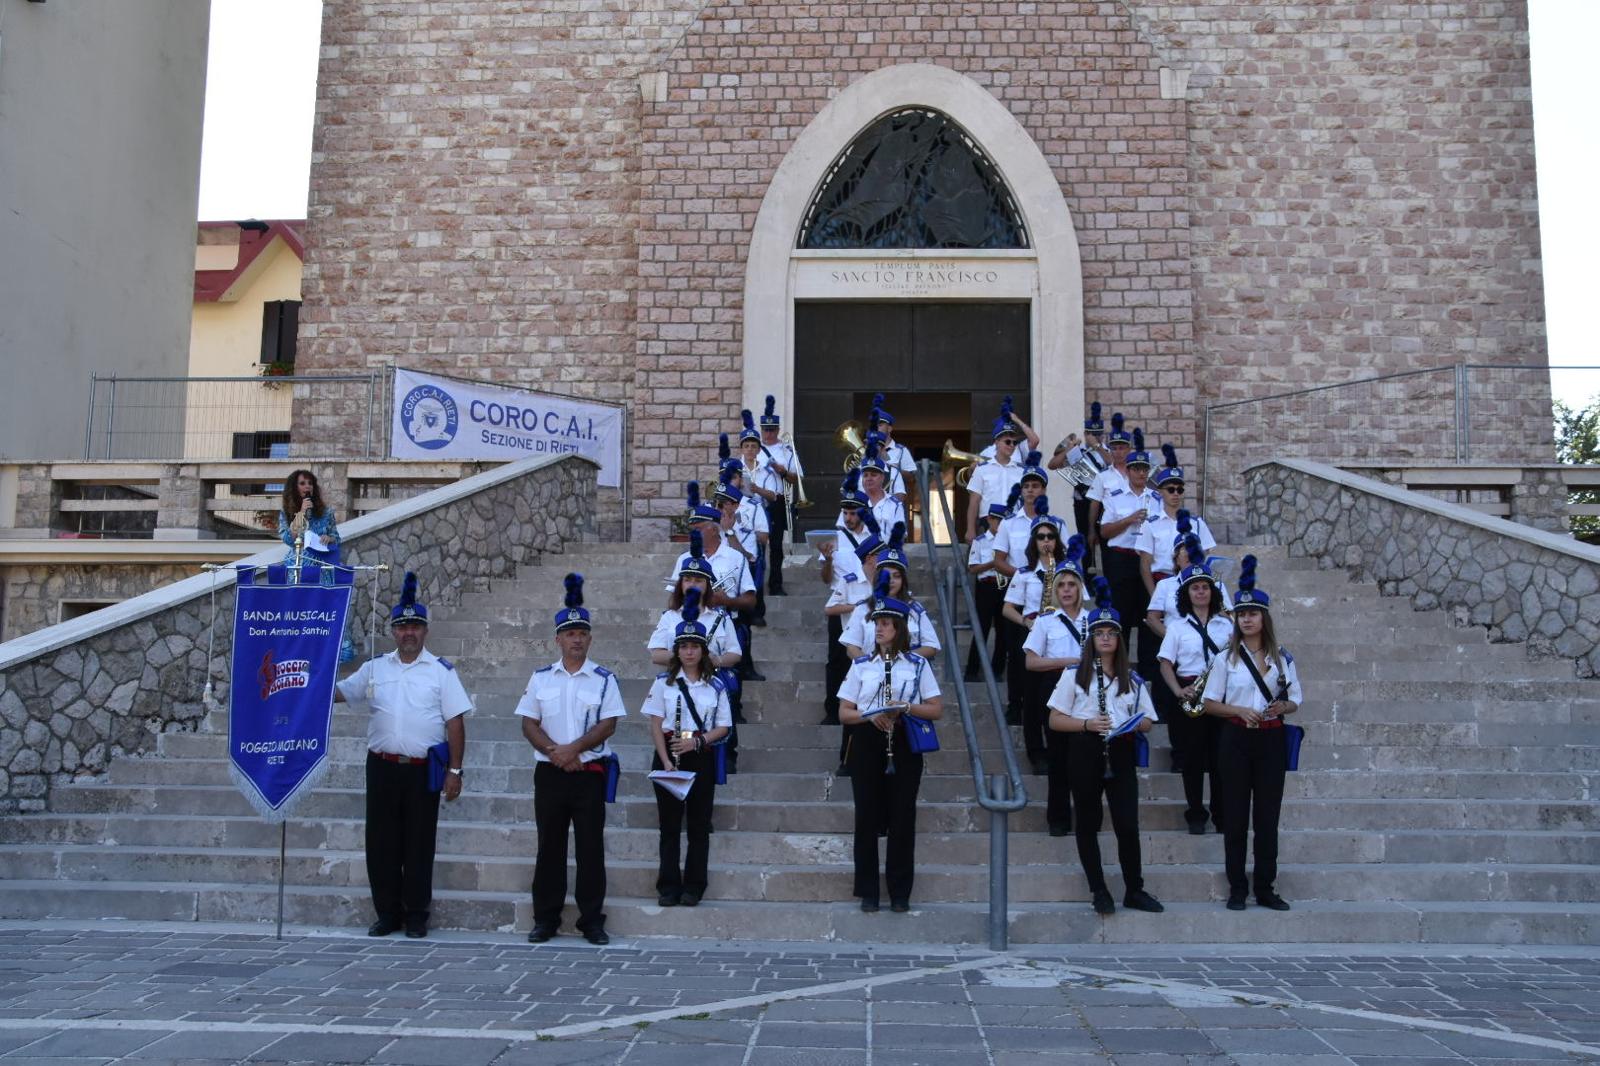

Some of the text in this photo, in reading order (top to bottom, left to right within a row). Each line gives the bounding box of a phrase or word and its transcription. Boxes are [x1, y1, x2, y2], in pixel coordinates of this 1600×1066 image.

[832, 271, 998, 283] SANCTO FRANCISCO
[404, 391, 421, 417] CORO
[443, 399, 456, 425] RIETI
[469, 399, 598, 441] CORO C.A.I.
[481, 429, 533, 450] SEZIONE
[535, 440, 547, 453] DI
[243, 610, 337, 622] BANDA MUSICALE
[249, 626, 331, 636] Don Antonio Santini
